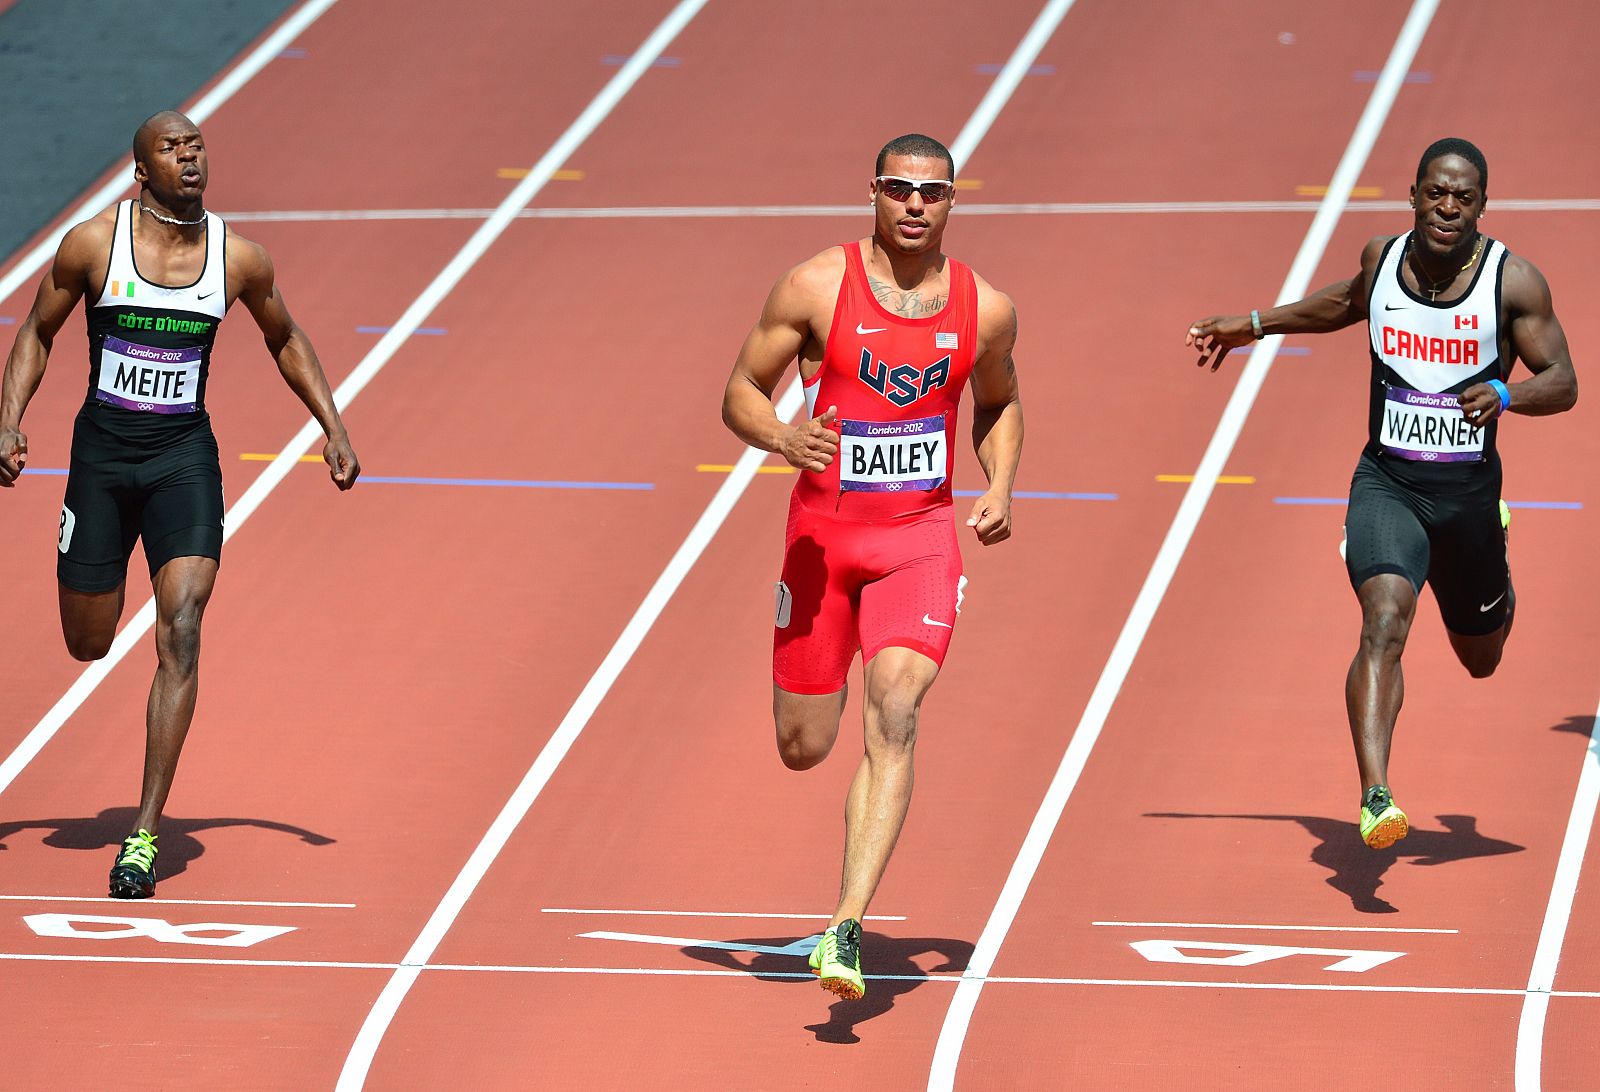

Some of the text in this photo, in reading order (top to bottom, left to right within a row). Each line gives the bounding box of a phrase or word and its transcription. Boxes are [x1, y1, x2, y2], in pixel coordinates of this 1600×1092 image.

[117, 312, 211, 335] CÔTE D'IVOIRE
[127, 345, 183, 362] London 2012
[1382, 326, 1479, 366] CANADA
[113, 361, 187, 399] MEITE
[858, 345, 951, 408] USA
[1406, 393, 1441, 407] London
[867, 422, 924, 436] London 2012
[1387, 408, 1480, 447] WARNER
[852, 439, 939, 476] BAILEY
[22, 913, 299, 948] 8
[1128, 939, 1409, 973] 5
